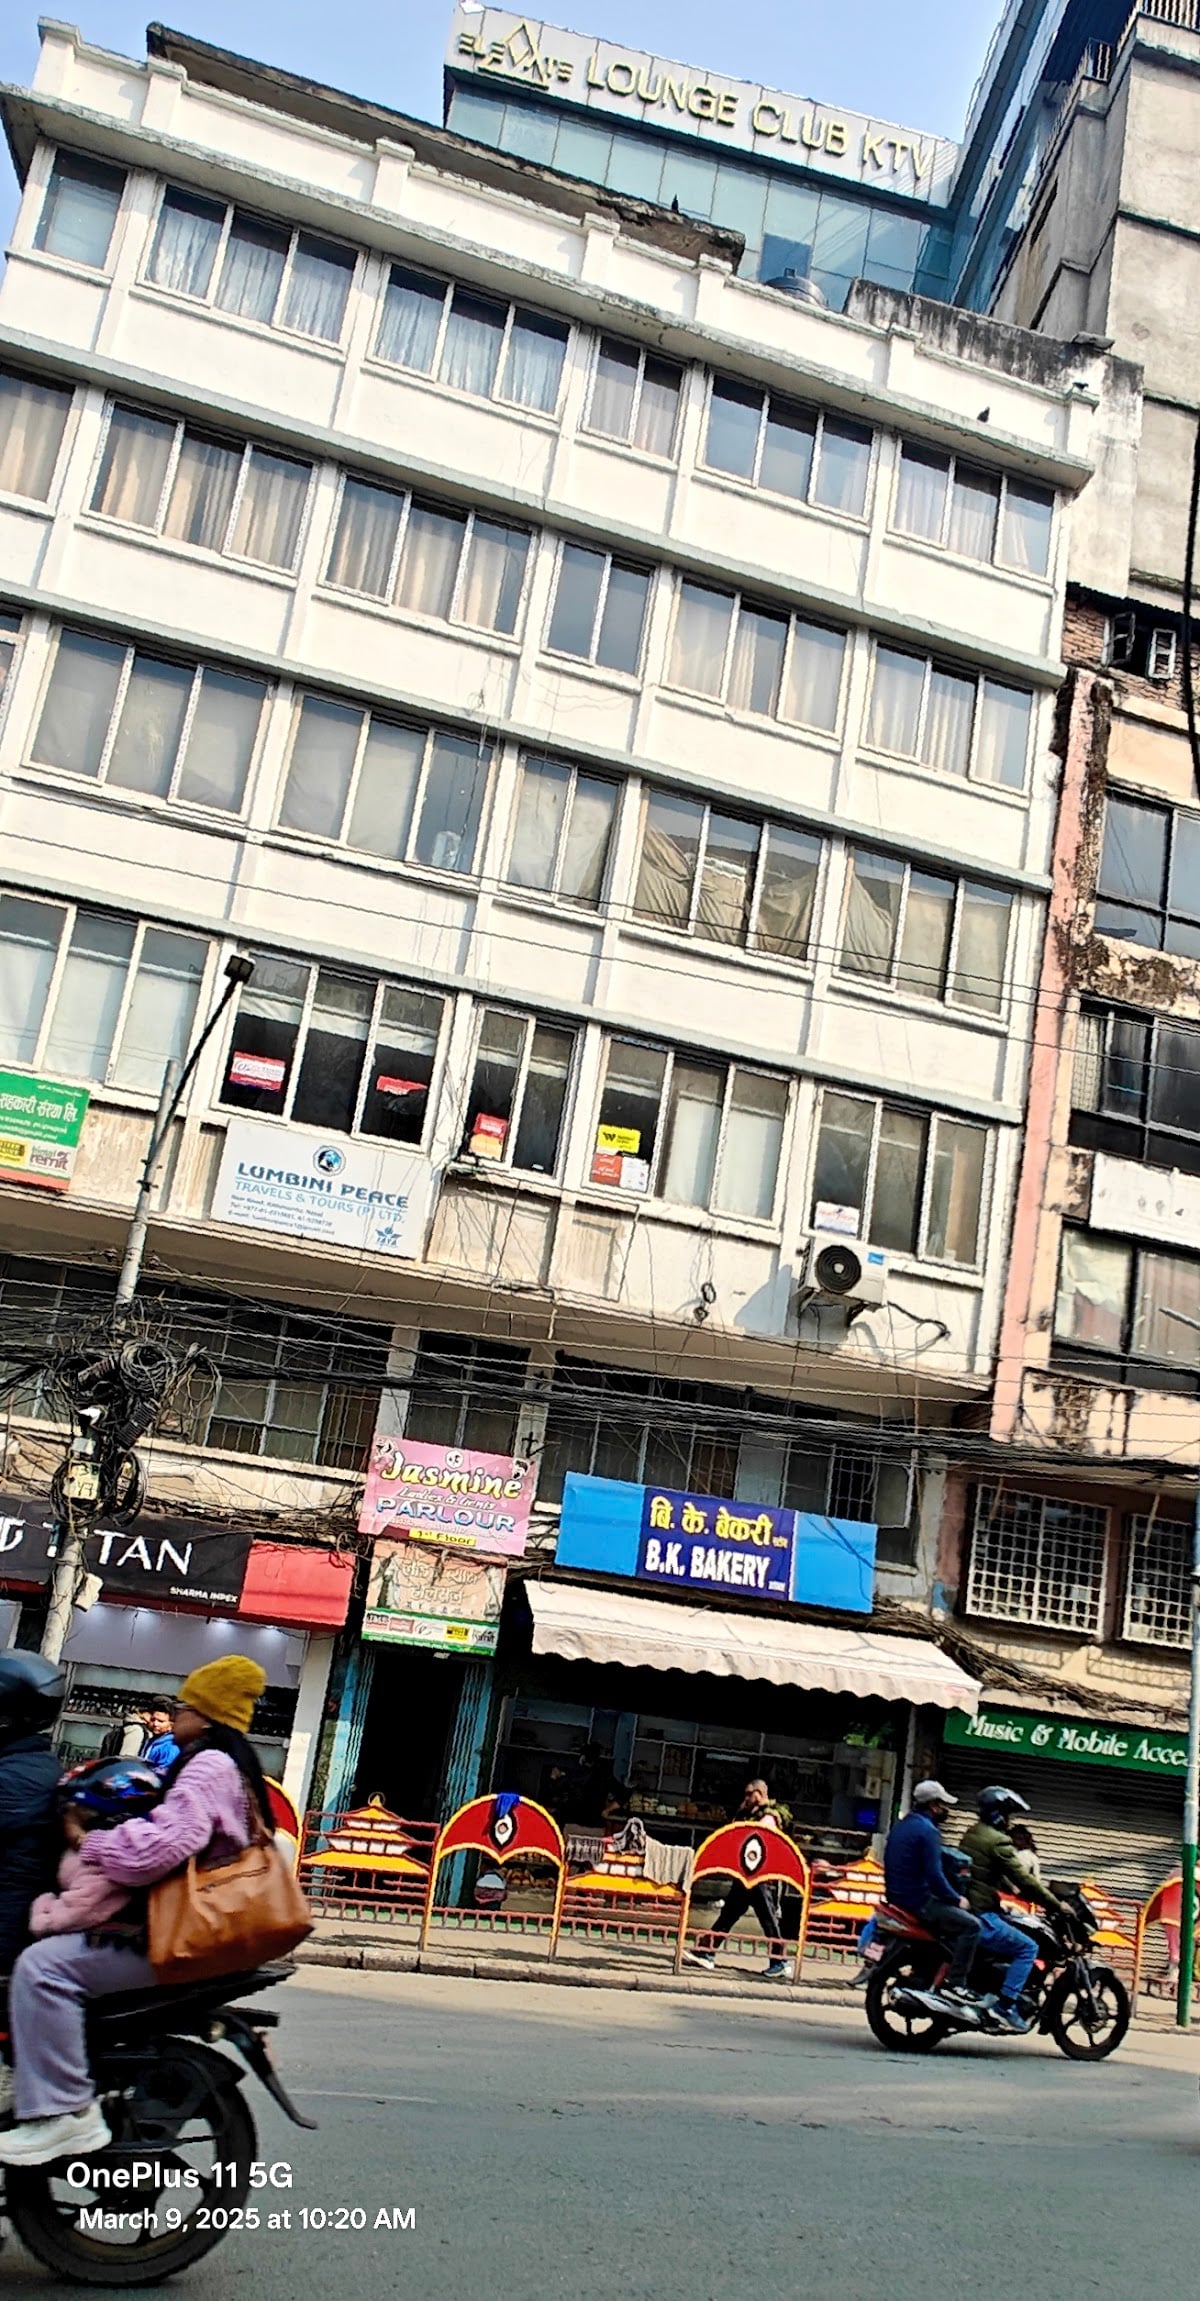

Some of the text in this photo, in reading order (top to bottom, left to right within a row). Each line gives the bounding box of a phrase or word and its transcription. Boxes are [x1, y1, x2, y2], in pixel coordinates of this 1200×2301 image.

[586, 51, 739, 128] LOUNGE
[751, 100, 850, 157] CLUB
[861, 129, 935, 181] KTV
[235, 1180, 292, 1202] TRAVELS
[295, 1192, 306, 1204] &
[310, 1196, 354, 1214] TOURS
[356, 1204, 376, 1220] (P)
[378, 1210, 406, 1225] LTD.
[237, 1162, 333, 1193] LUMBINI
[340, 1183, 409, 1210] PEACE
[381, 1451, 523, 1499] Jasmine
[399, 1486, 444, 1504] Ladies
[376, 1497, 516, 1533] PARLOUR
[436, 1531, 473, 1546] Floor
[650, 1495, 773, 1547] बि. के. बेकरी
[645, 1538, 771, 1588] B.K. BAKERY
[964, 1714, 1191, 1766] Music & Mobile Acce
